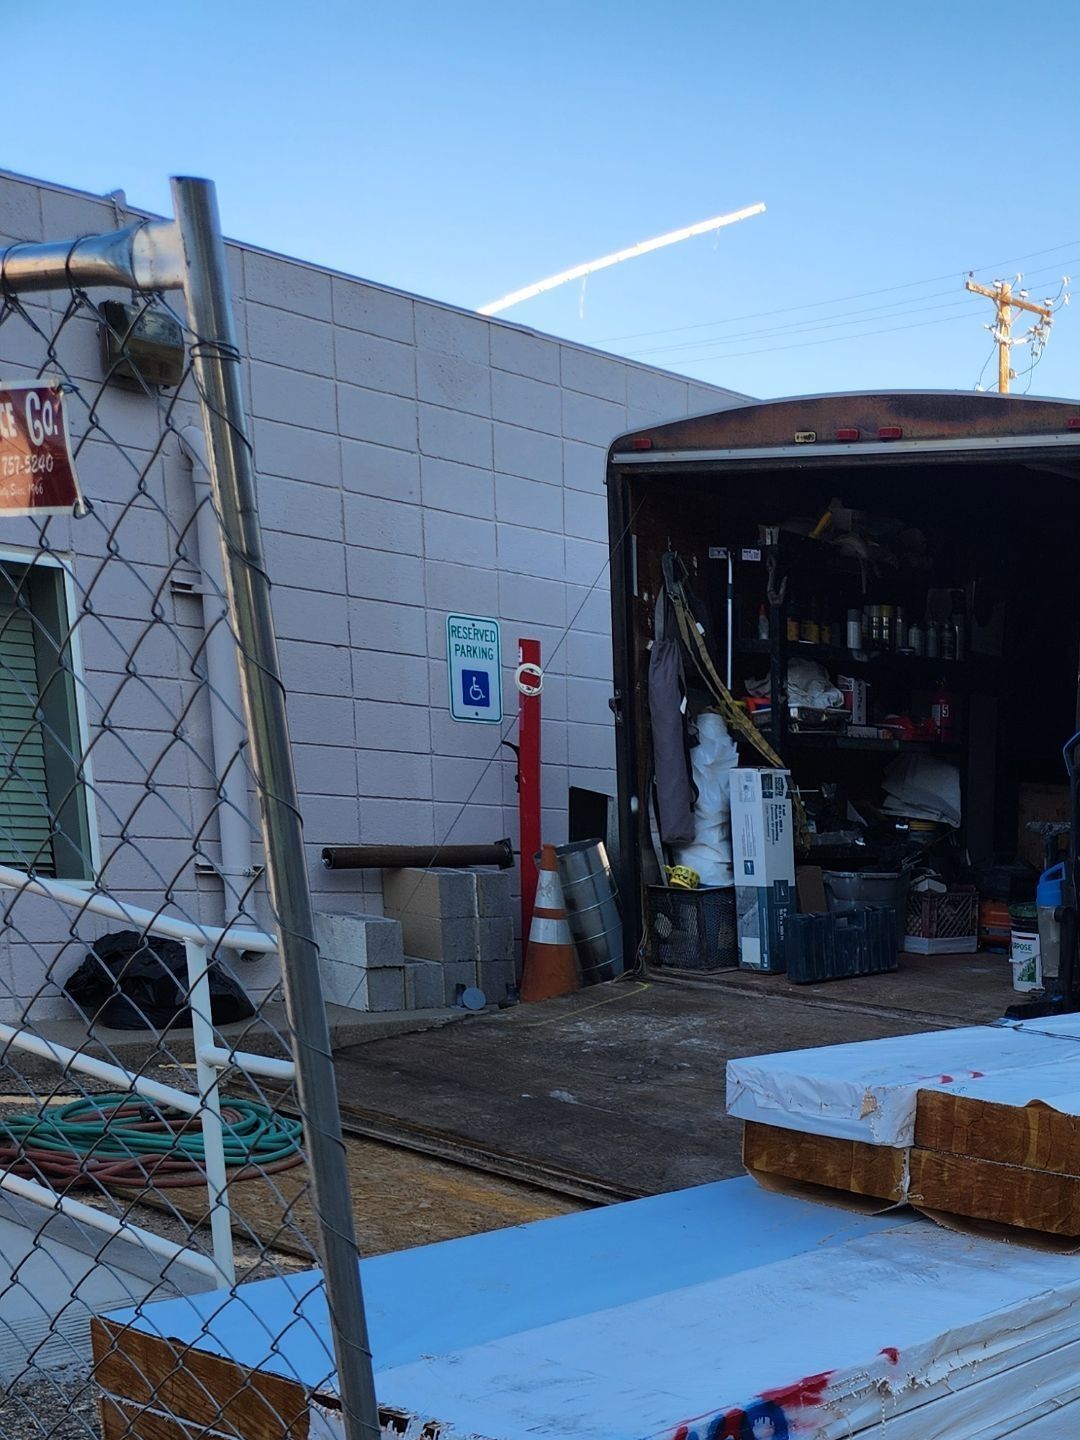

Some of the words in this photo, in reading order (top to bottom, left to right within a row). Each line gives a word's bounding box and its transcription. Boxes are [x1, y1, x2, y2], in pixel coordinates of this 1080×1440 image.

[26, 391, 58, 446] Co.
[451, 625, 496, 643] RESERVED
[454, 643, 494, 661] PARKING
